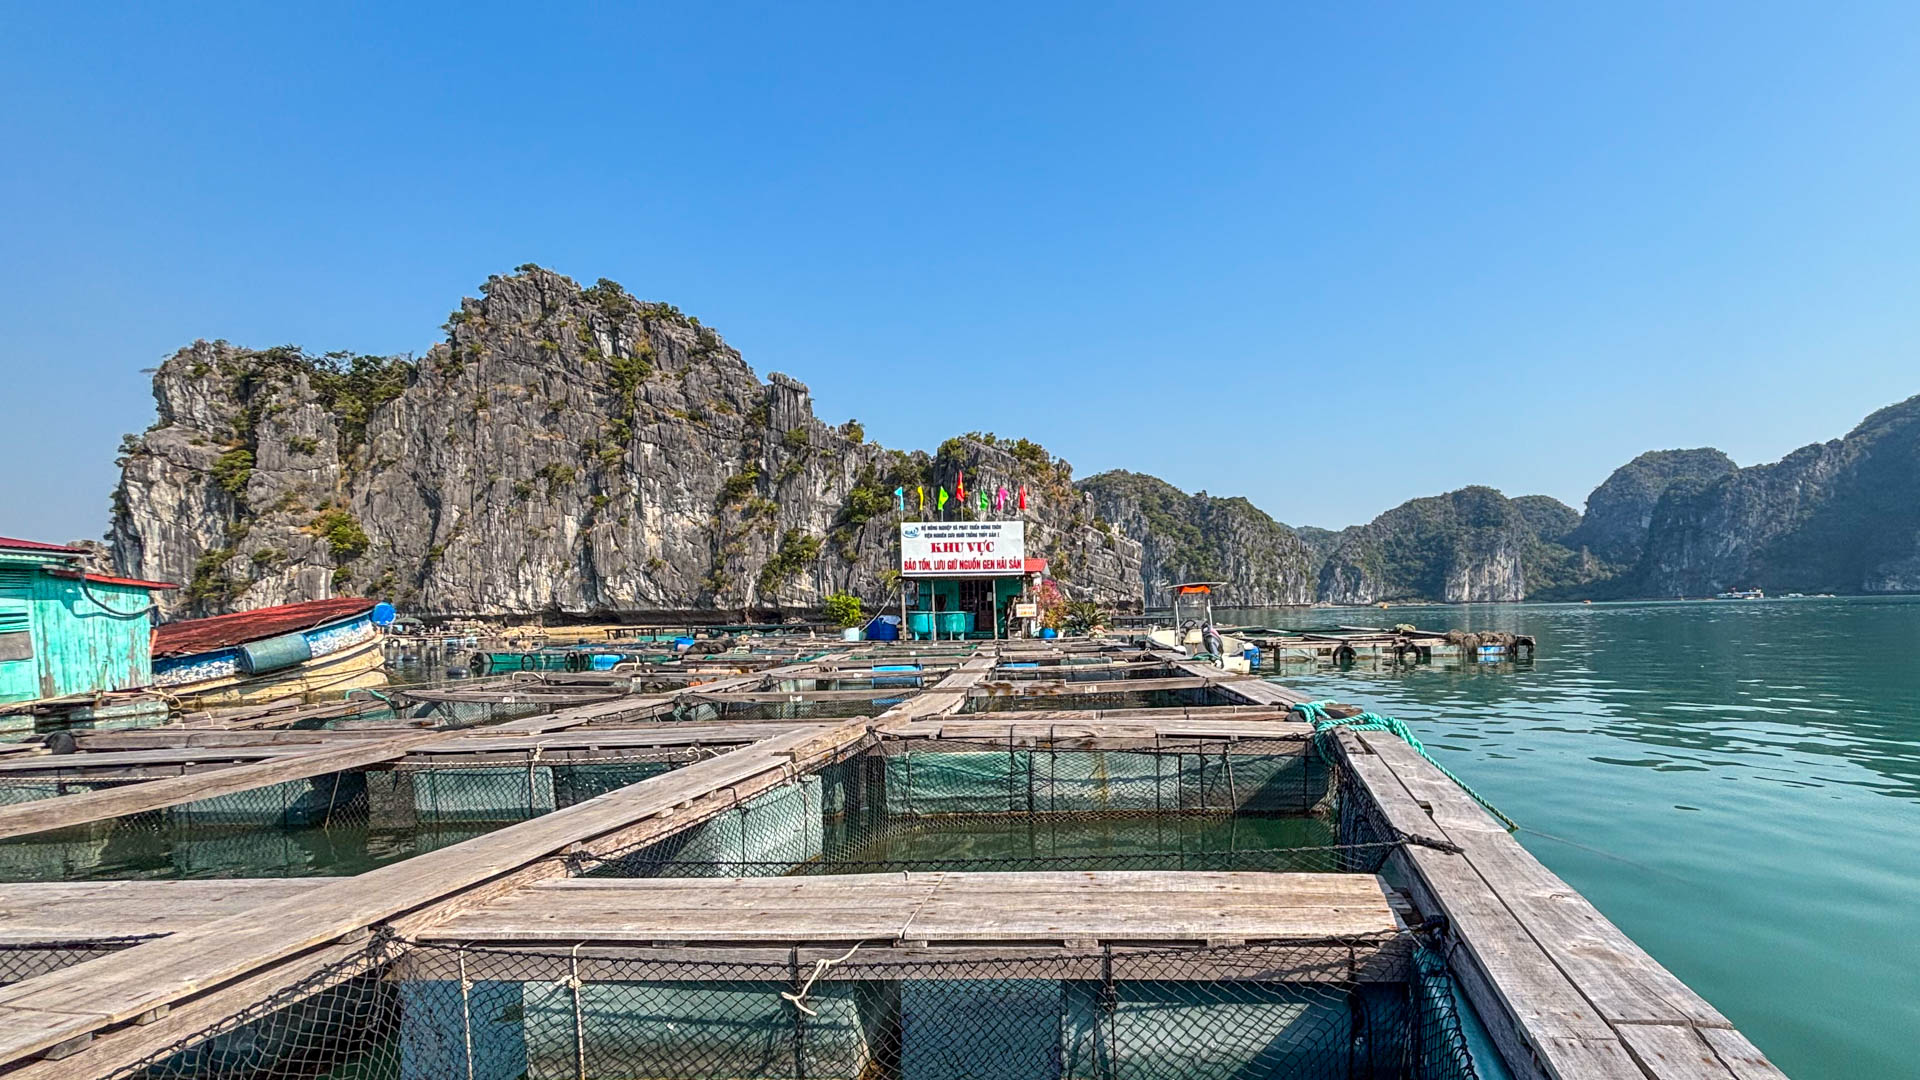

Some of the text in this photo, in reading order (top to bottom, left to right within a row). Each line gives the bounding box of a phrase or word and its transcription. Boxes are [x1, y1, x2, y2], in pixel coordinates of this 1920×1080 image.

[930, 539, 995, 556] KHU VỰC
[904, 557, 916, 571] BẢO
[934, 559, 945, 570] LƯU
[947, 558, 958, 570] GIỮ
[982, 559, 995, 570] GEN
[997, 556, 1007, 569] HẢI
[1009, 556, 1022, 569] SẢN
